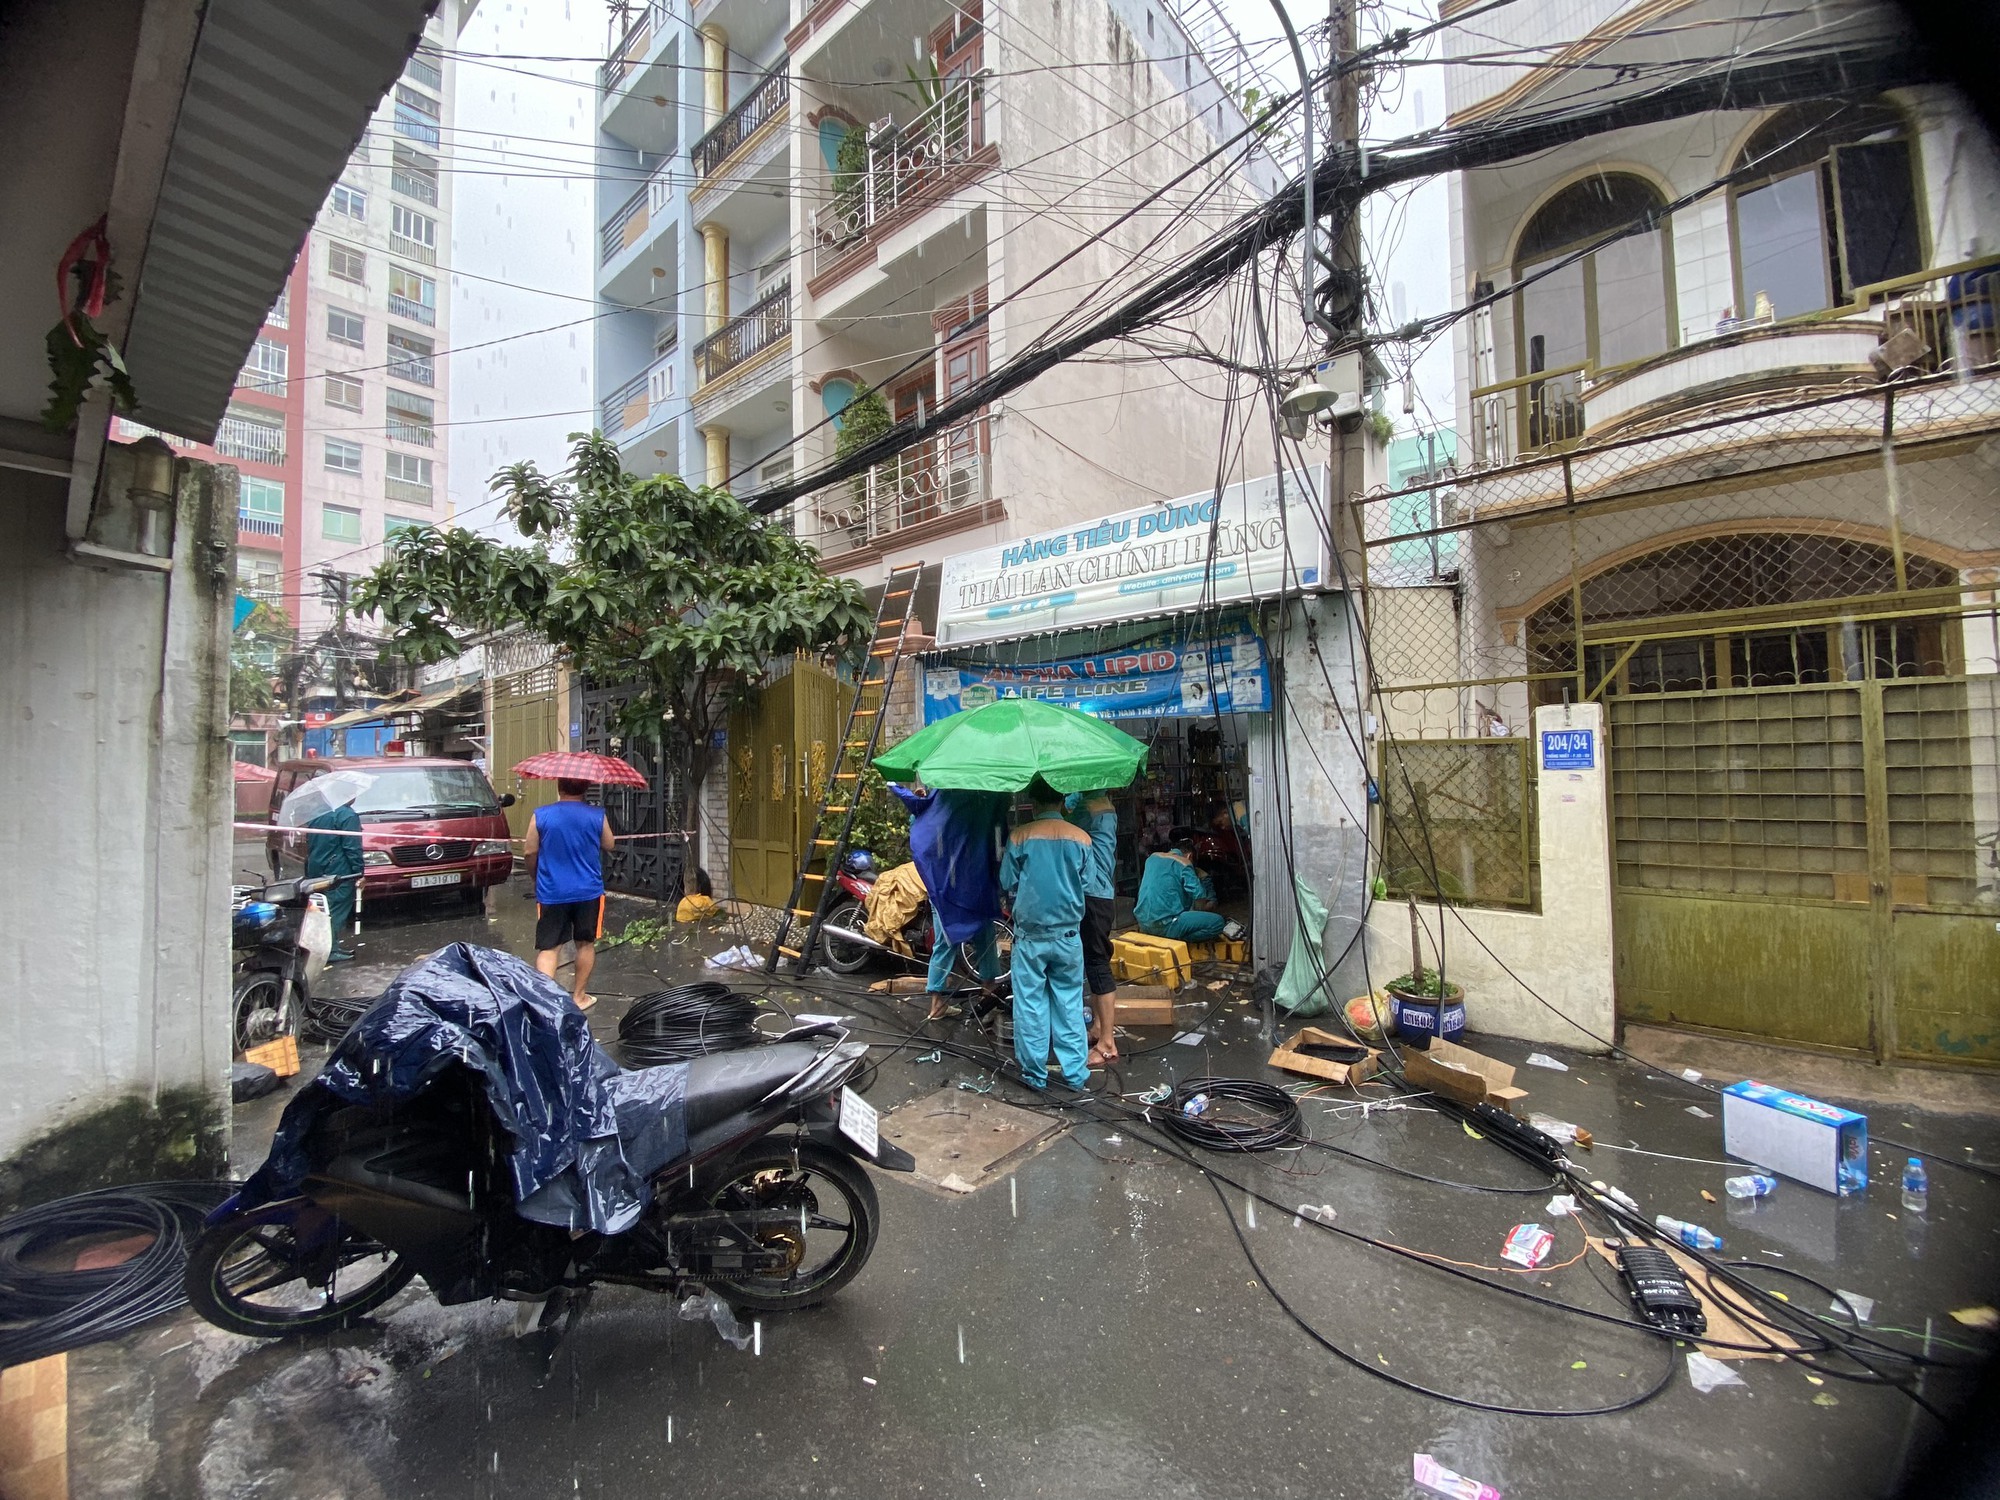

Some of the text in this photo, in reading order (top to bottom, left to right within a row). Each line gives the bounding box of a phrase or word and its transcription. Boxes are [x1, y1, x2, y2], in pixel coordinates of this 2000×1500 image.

[1001, 534, 1068, 569] HÀNG
[1075, 519, 1131, 552] TIÊU
[1137, 498, 1221, 538] DÙNG
[960, 570, 1017, 609] THÁI
[1022, 561, 1074, 596] LAN
[1078, 540, 1178, 584] CHÍNH
[1185, 517, 1284, 564] HÃNG
[982, 650, 1176, 683] ALPHA LIPID
[1075, 678, 1150, 697] LINE
[1119, 709, 1136, 718] NAM
[1168, 705, 1178, 714] 21
[1547, 733, 1588, 753] 204/34
